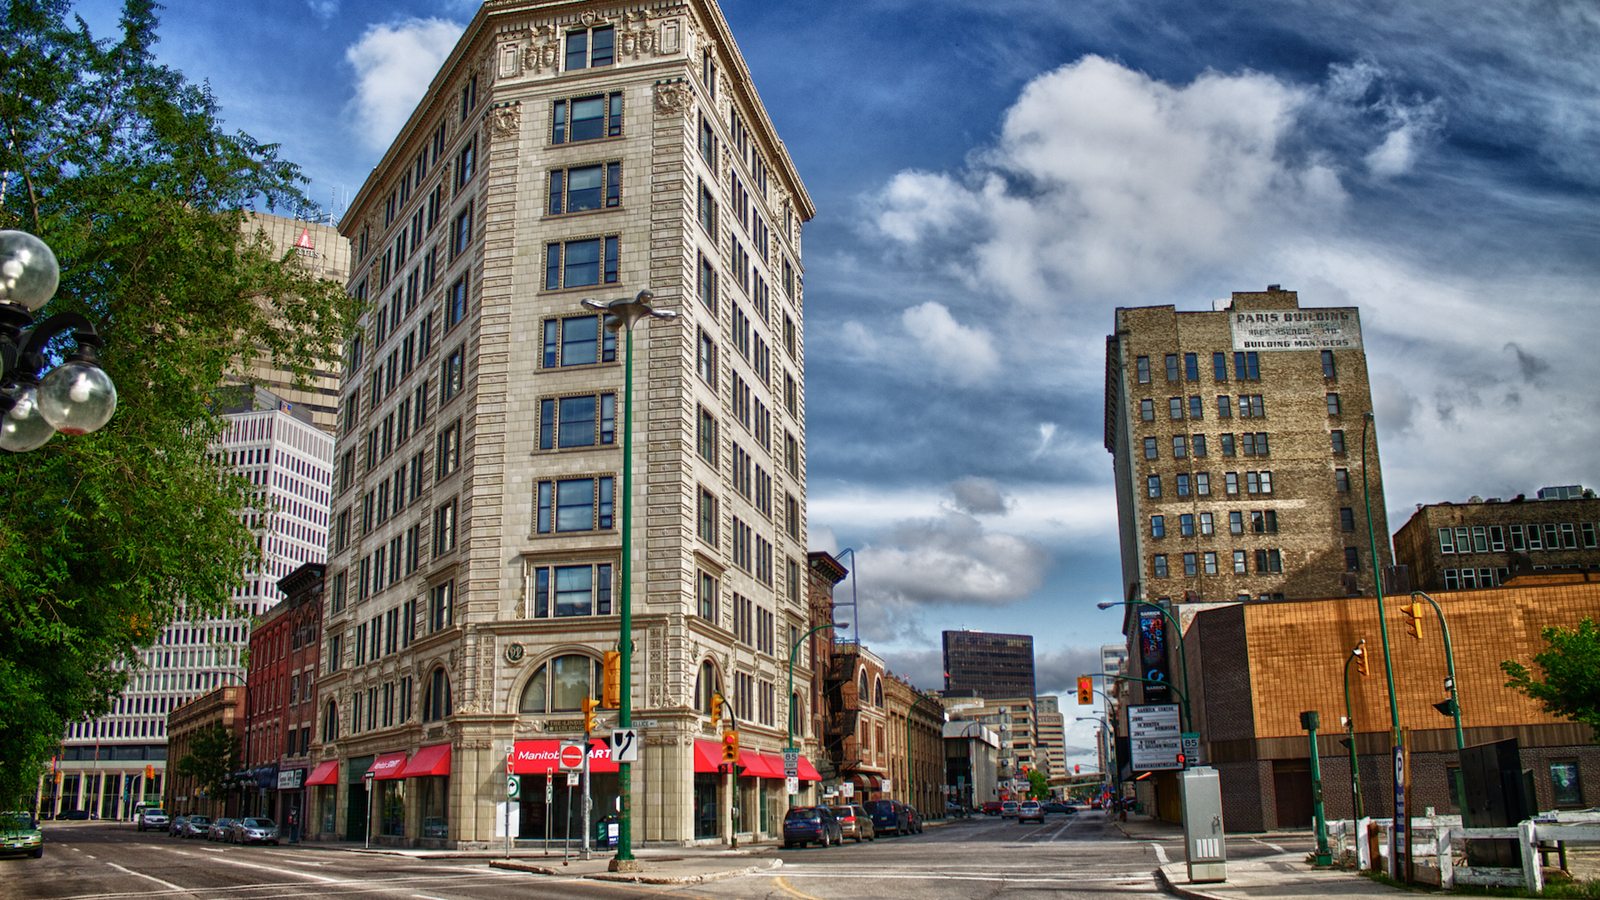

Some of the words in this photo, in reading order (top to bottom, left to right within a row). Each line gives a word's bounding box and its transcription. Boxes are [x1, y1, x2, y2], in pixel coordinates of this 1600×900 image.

[1237, 313, 1279, 323] PARIS
[1284, 312, 1349, 322] BUILDING
[1185, 739, 1197, 747] 85
[518, 751, 559, 760] Manitob
[586, 749, 611, 758] ART
